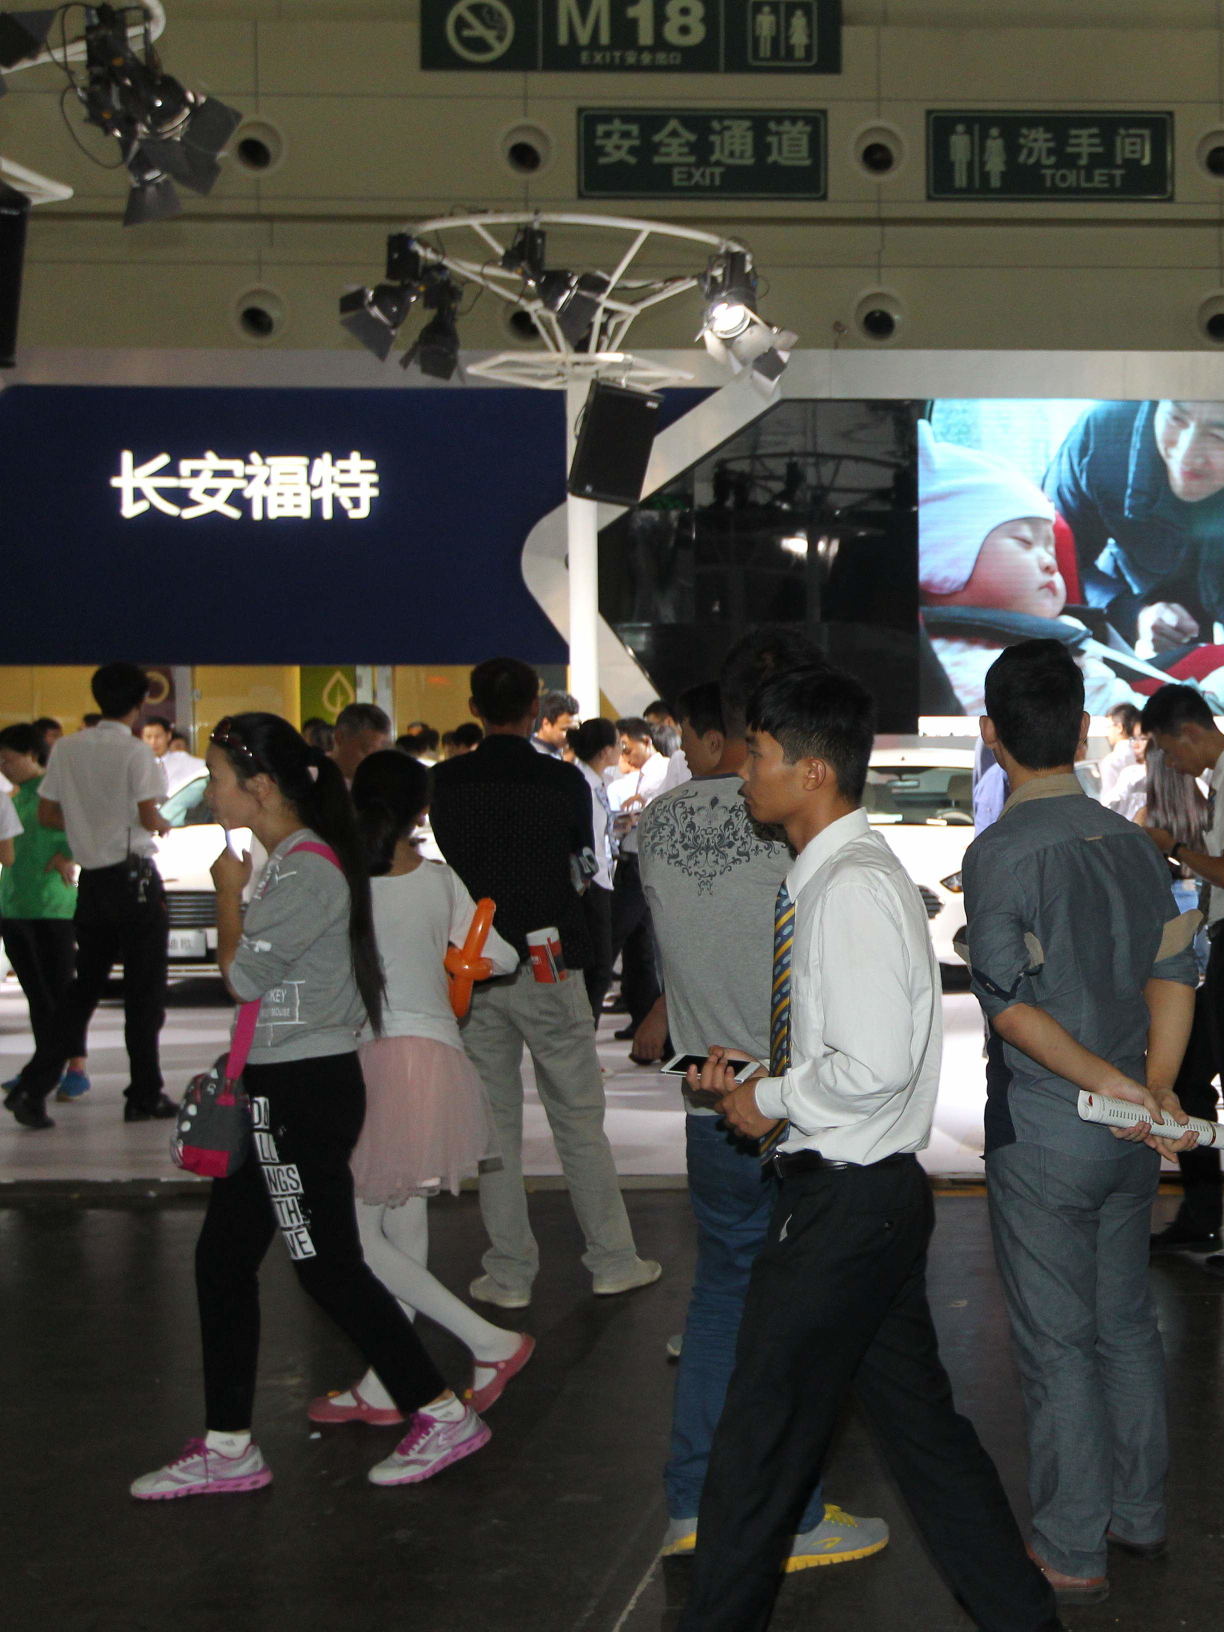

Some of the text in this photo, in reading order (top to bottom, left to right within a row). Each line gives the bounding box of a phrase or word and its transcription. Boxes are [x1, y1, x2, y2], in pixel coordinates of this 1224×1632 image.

[595, 118, 812, 167] 安全通道
[1017, 126, 1152, 167] 洗手间
[671, 167, 726, 188] EXIT
[1041, 168, 1126, 189] TOILET
[110, 449, 380, 521] 长安福特
